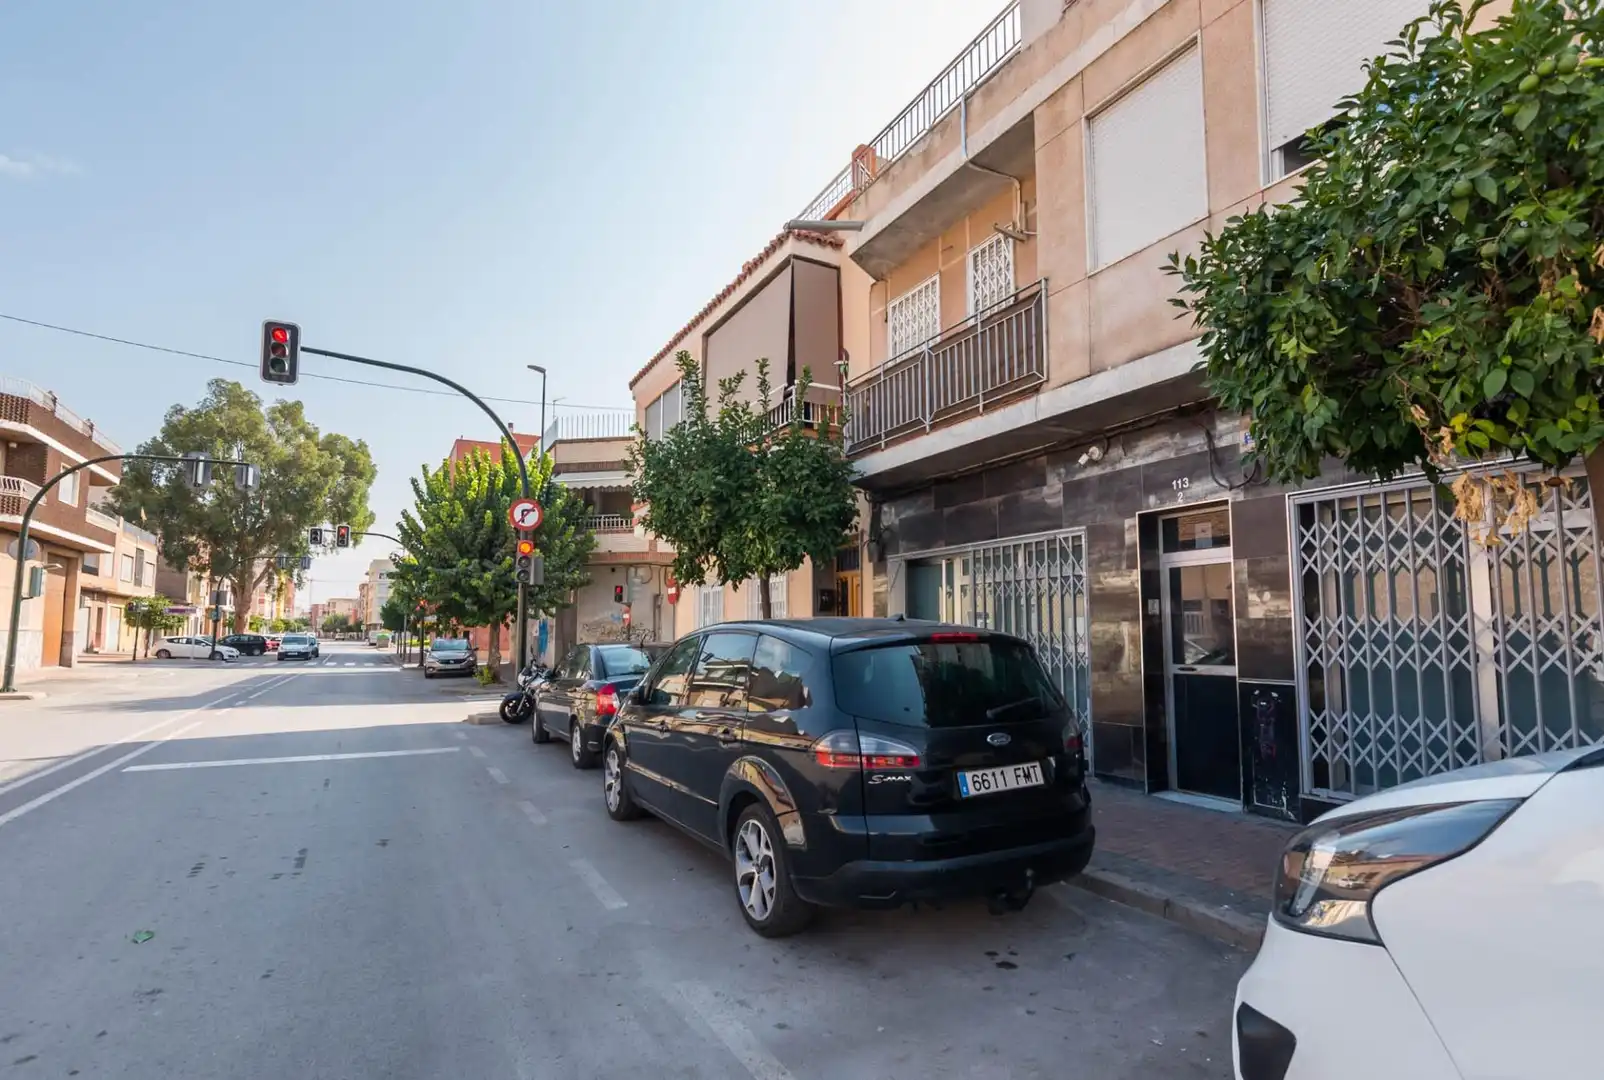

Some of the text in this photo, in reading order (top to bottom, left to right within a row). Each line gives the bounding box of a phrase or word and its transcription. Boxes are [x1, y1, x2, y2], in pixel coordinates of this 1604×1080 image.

[1171, 477, 1189, 490] 113
[1177, 491, 1184, 502] 2
[971, 765, 1038, 792] 6611 FMT
